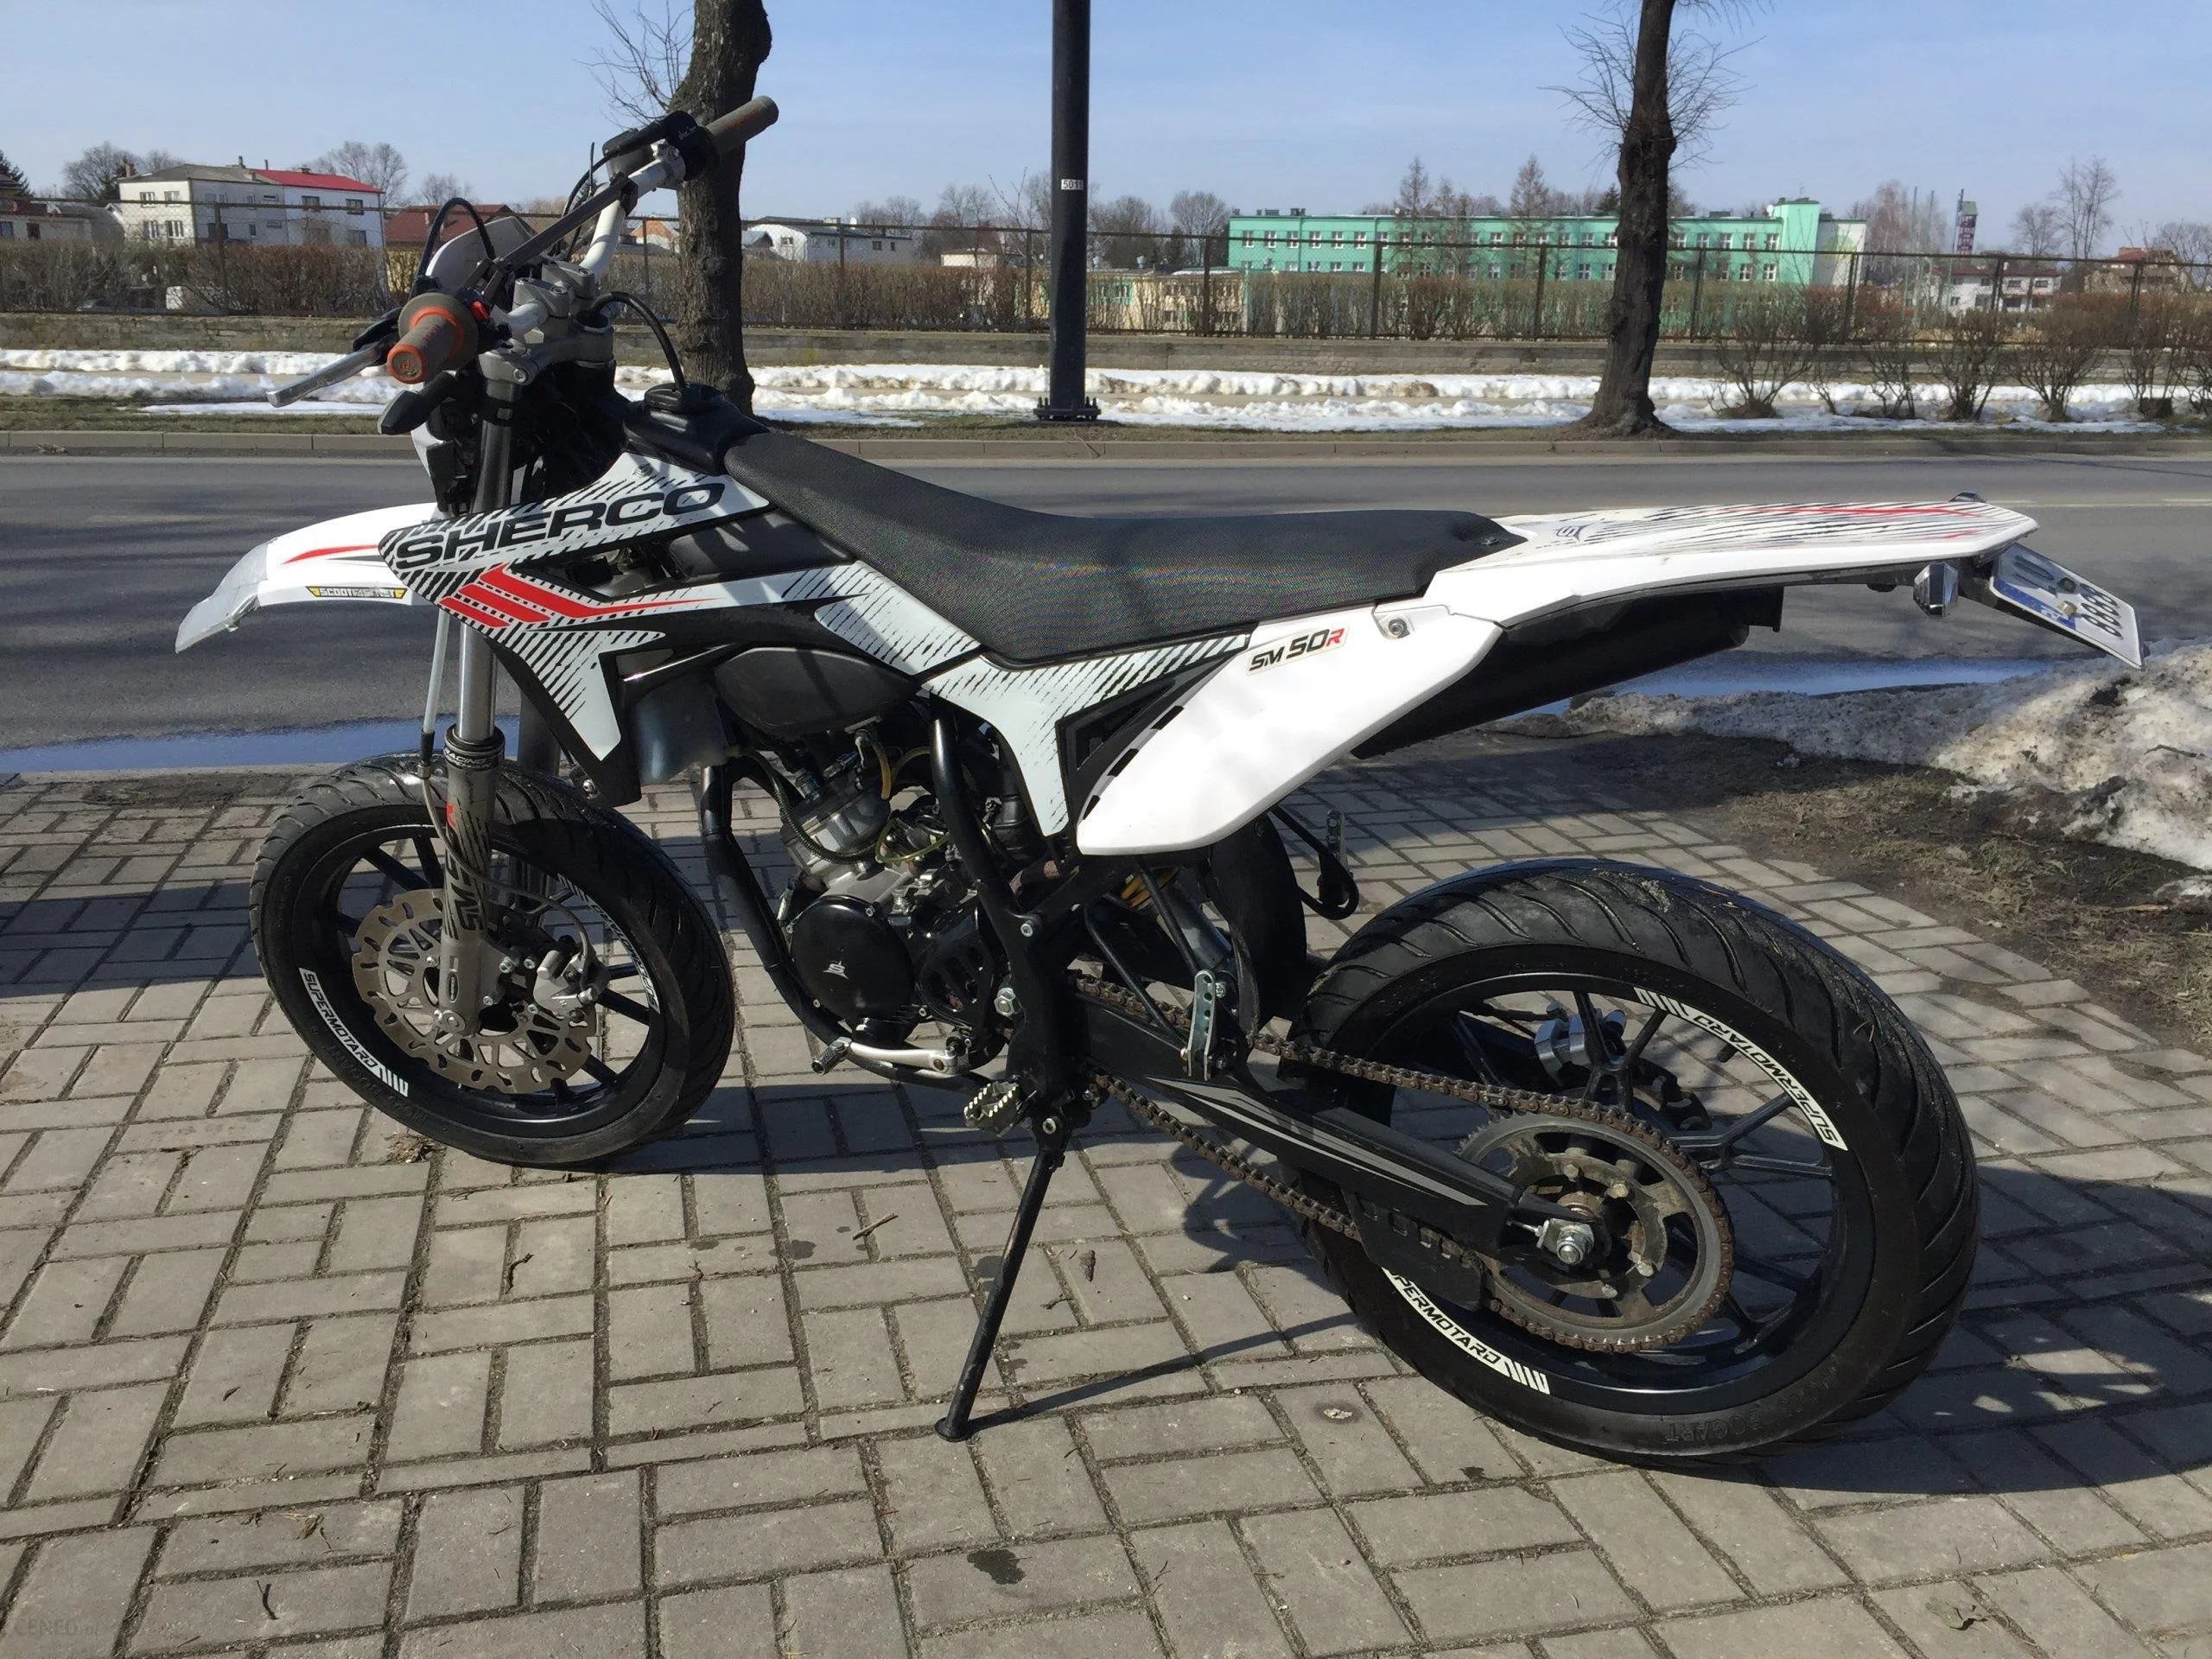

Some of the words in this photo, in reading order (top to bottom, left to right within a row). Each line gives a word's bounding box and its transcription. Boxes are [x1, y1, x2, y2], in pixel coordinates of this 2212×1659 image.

[396, 482, 726, 570] SHERCO
[1249, 645, 1285, 671] SM
[1286, 628, 1345, 659] 50R
[2080, 583, 2124, 639] 8888
[303, 971, 378, 1069] SUPERMOTARD
[1693, 1014, 1840, 1143] SUPERMOTARD
